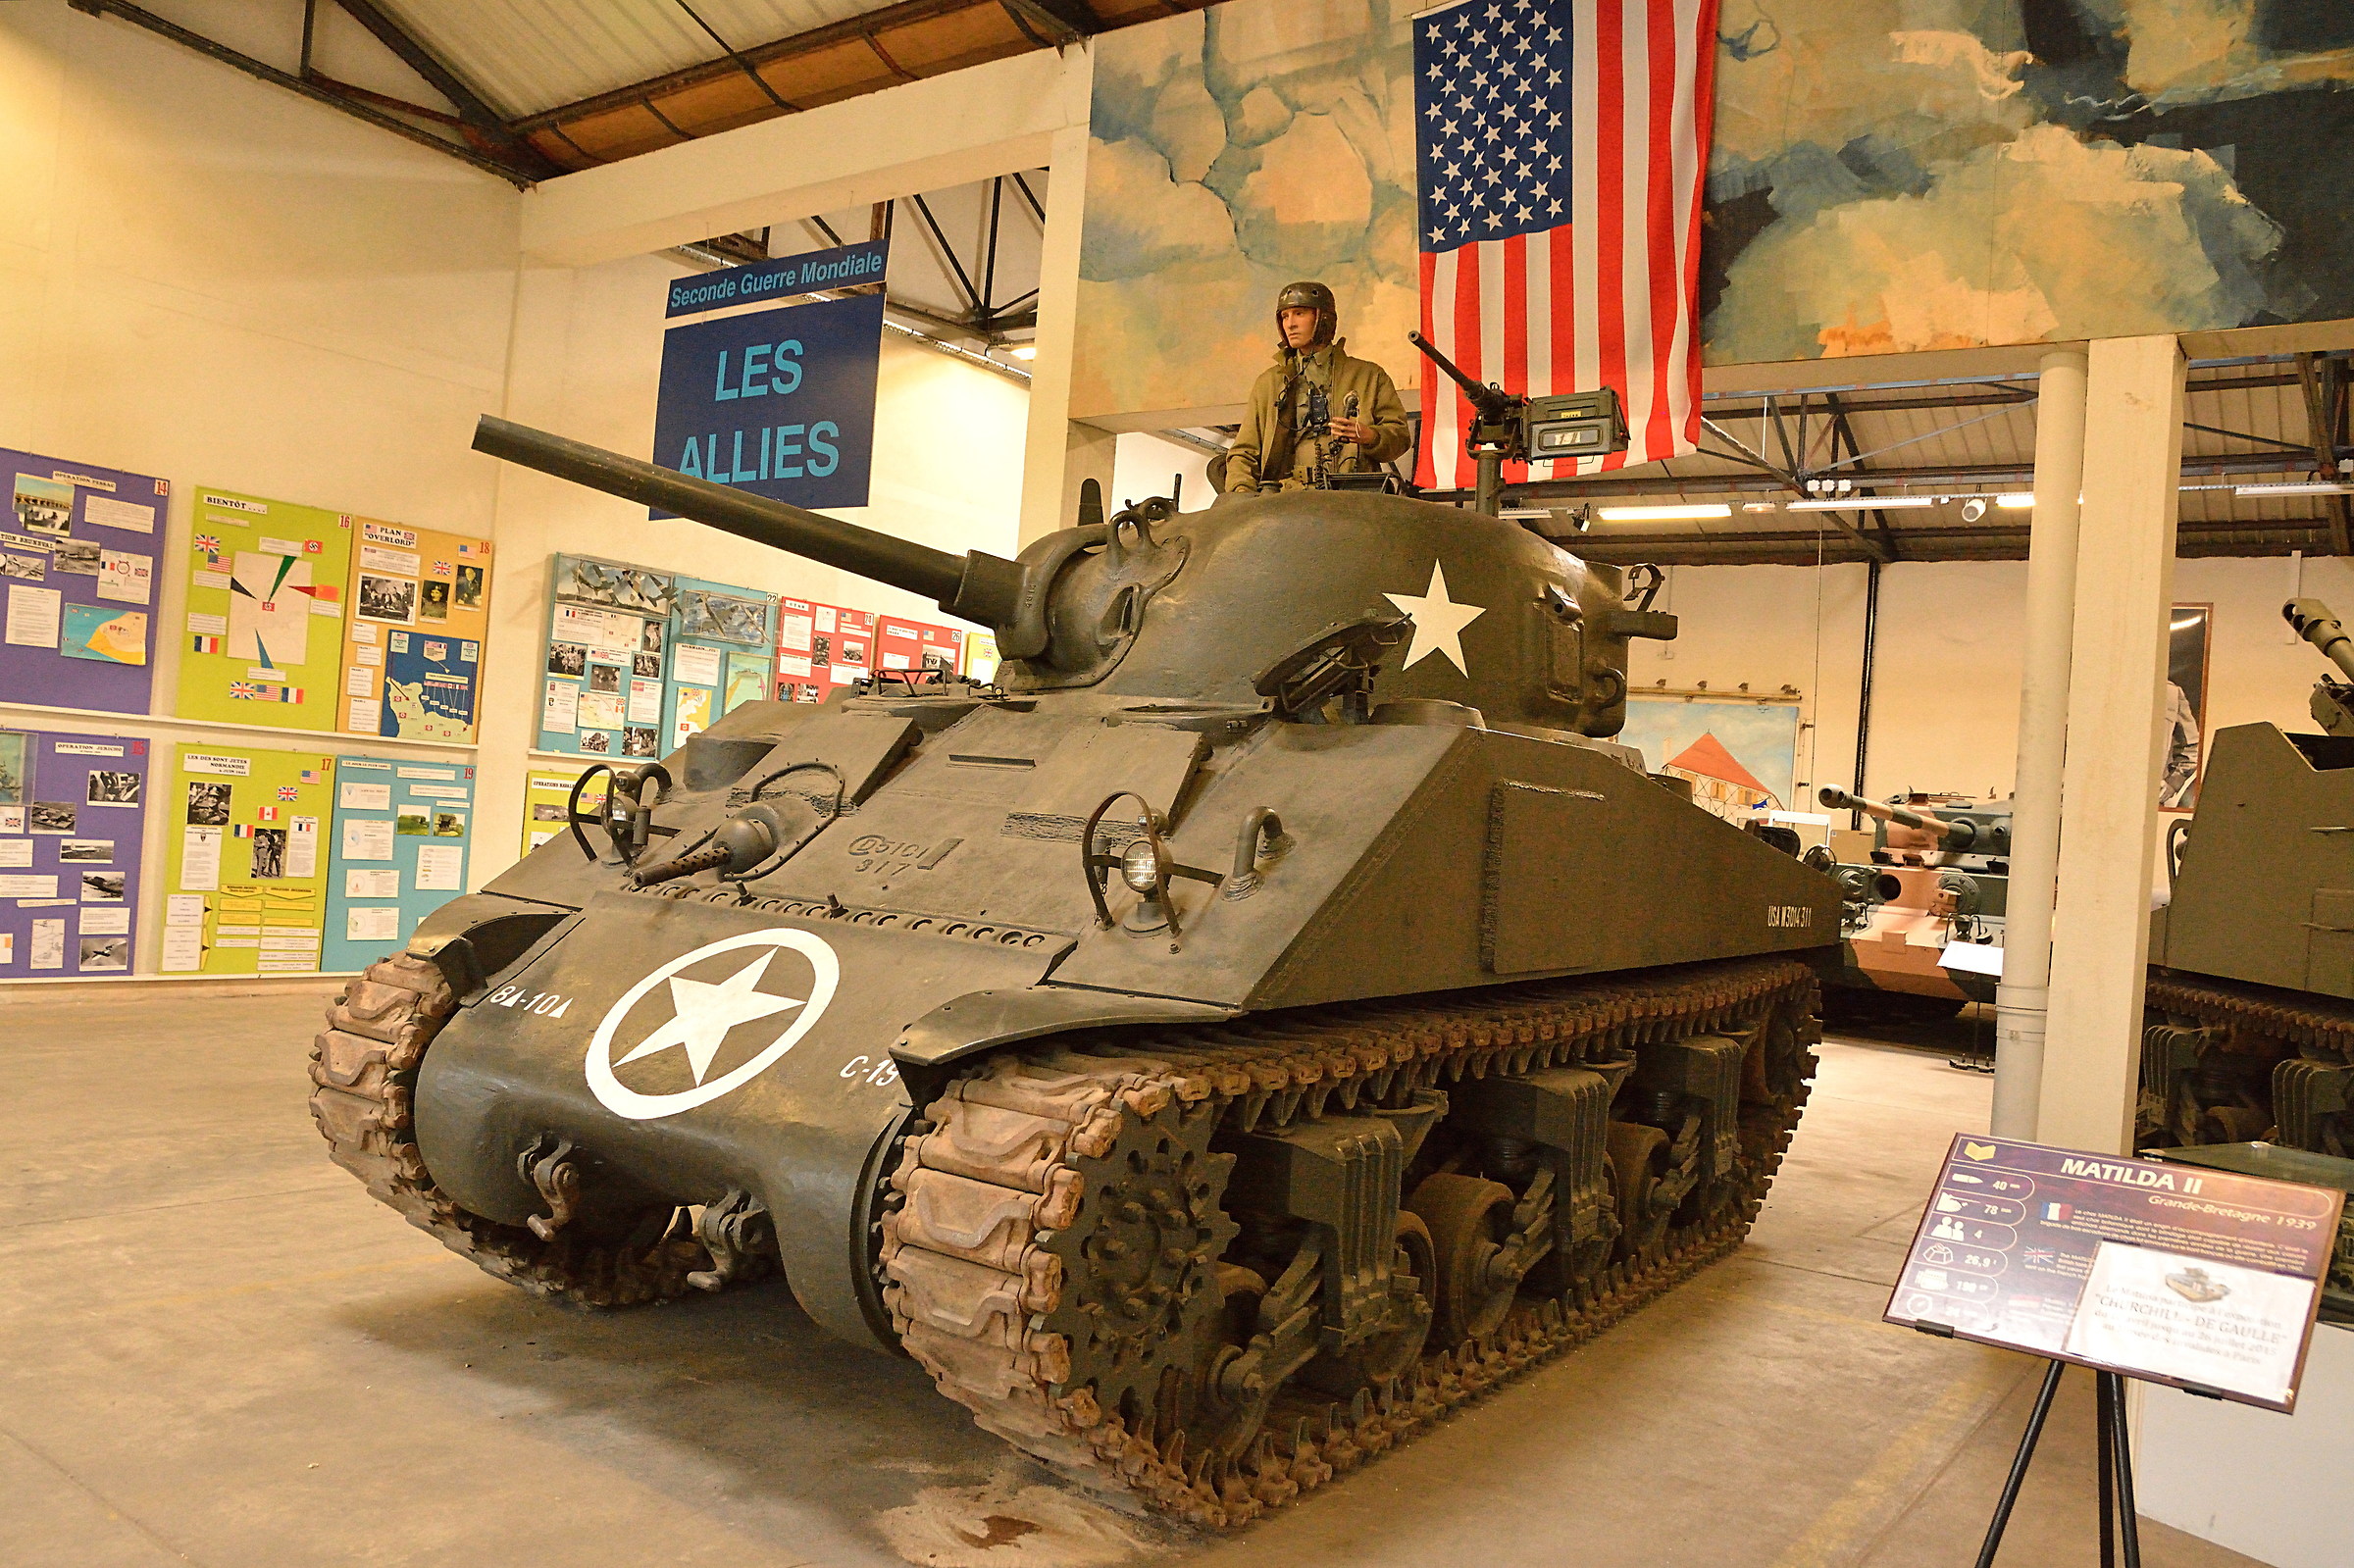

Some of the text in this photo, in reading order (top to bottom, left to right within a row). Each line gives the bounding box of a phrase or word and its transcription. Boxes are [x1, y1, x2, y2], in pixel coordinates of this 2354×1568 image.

[671, 252, 882, 308] Seconde Guerre Mondiale
[715, 339, 803, 401] LES
[679, 421, 840, 484] ALLIES
[157, 481, 167, 495] 14
[207, 496, 246, 509] BIENTÔT
[339, 515, 350, 528] 16
[380, 527, 401, 535] PLAN
[365, 532, 415, 546] "OVERLORD"
[480, 542, 489, 554] 18
[951, 632, 960, 641] 26
[321, 758, 332, 771] 17
[464, 767, 474, 780] 19
[1767, 905, 1780, 927] USA
[2061, 1158, 2202, 1194] MATILDA II
[1993, 1180, 2008, 1190] 40
[1983, 1203, 1999, 1215] 78
[2148, 1194, 2318, 1230] Grande-Bretagne 1939
[1974, 1230, 1983, 1239] 4
[2195, 1316, 2216, 1330] DE
